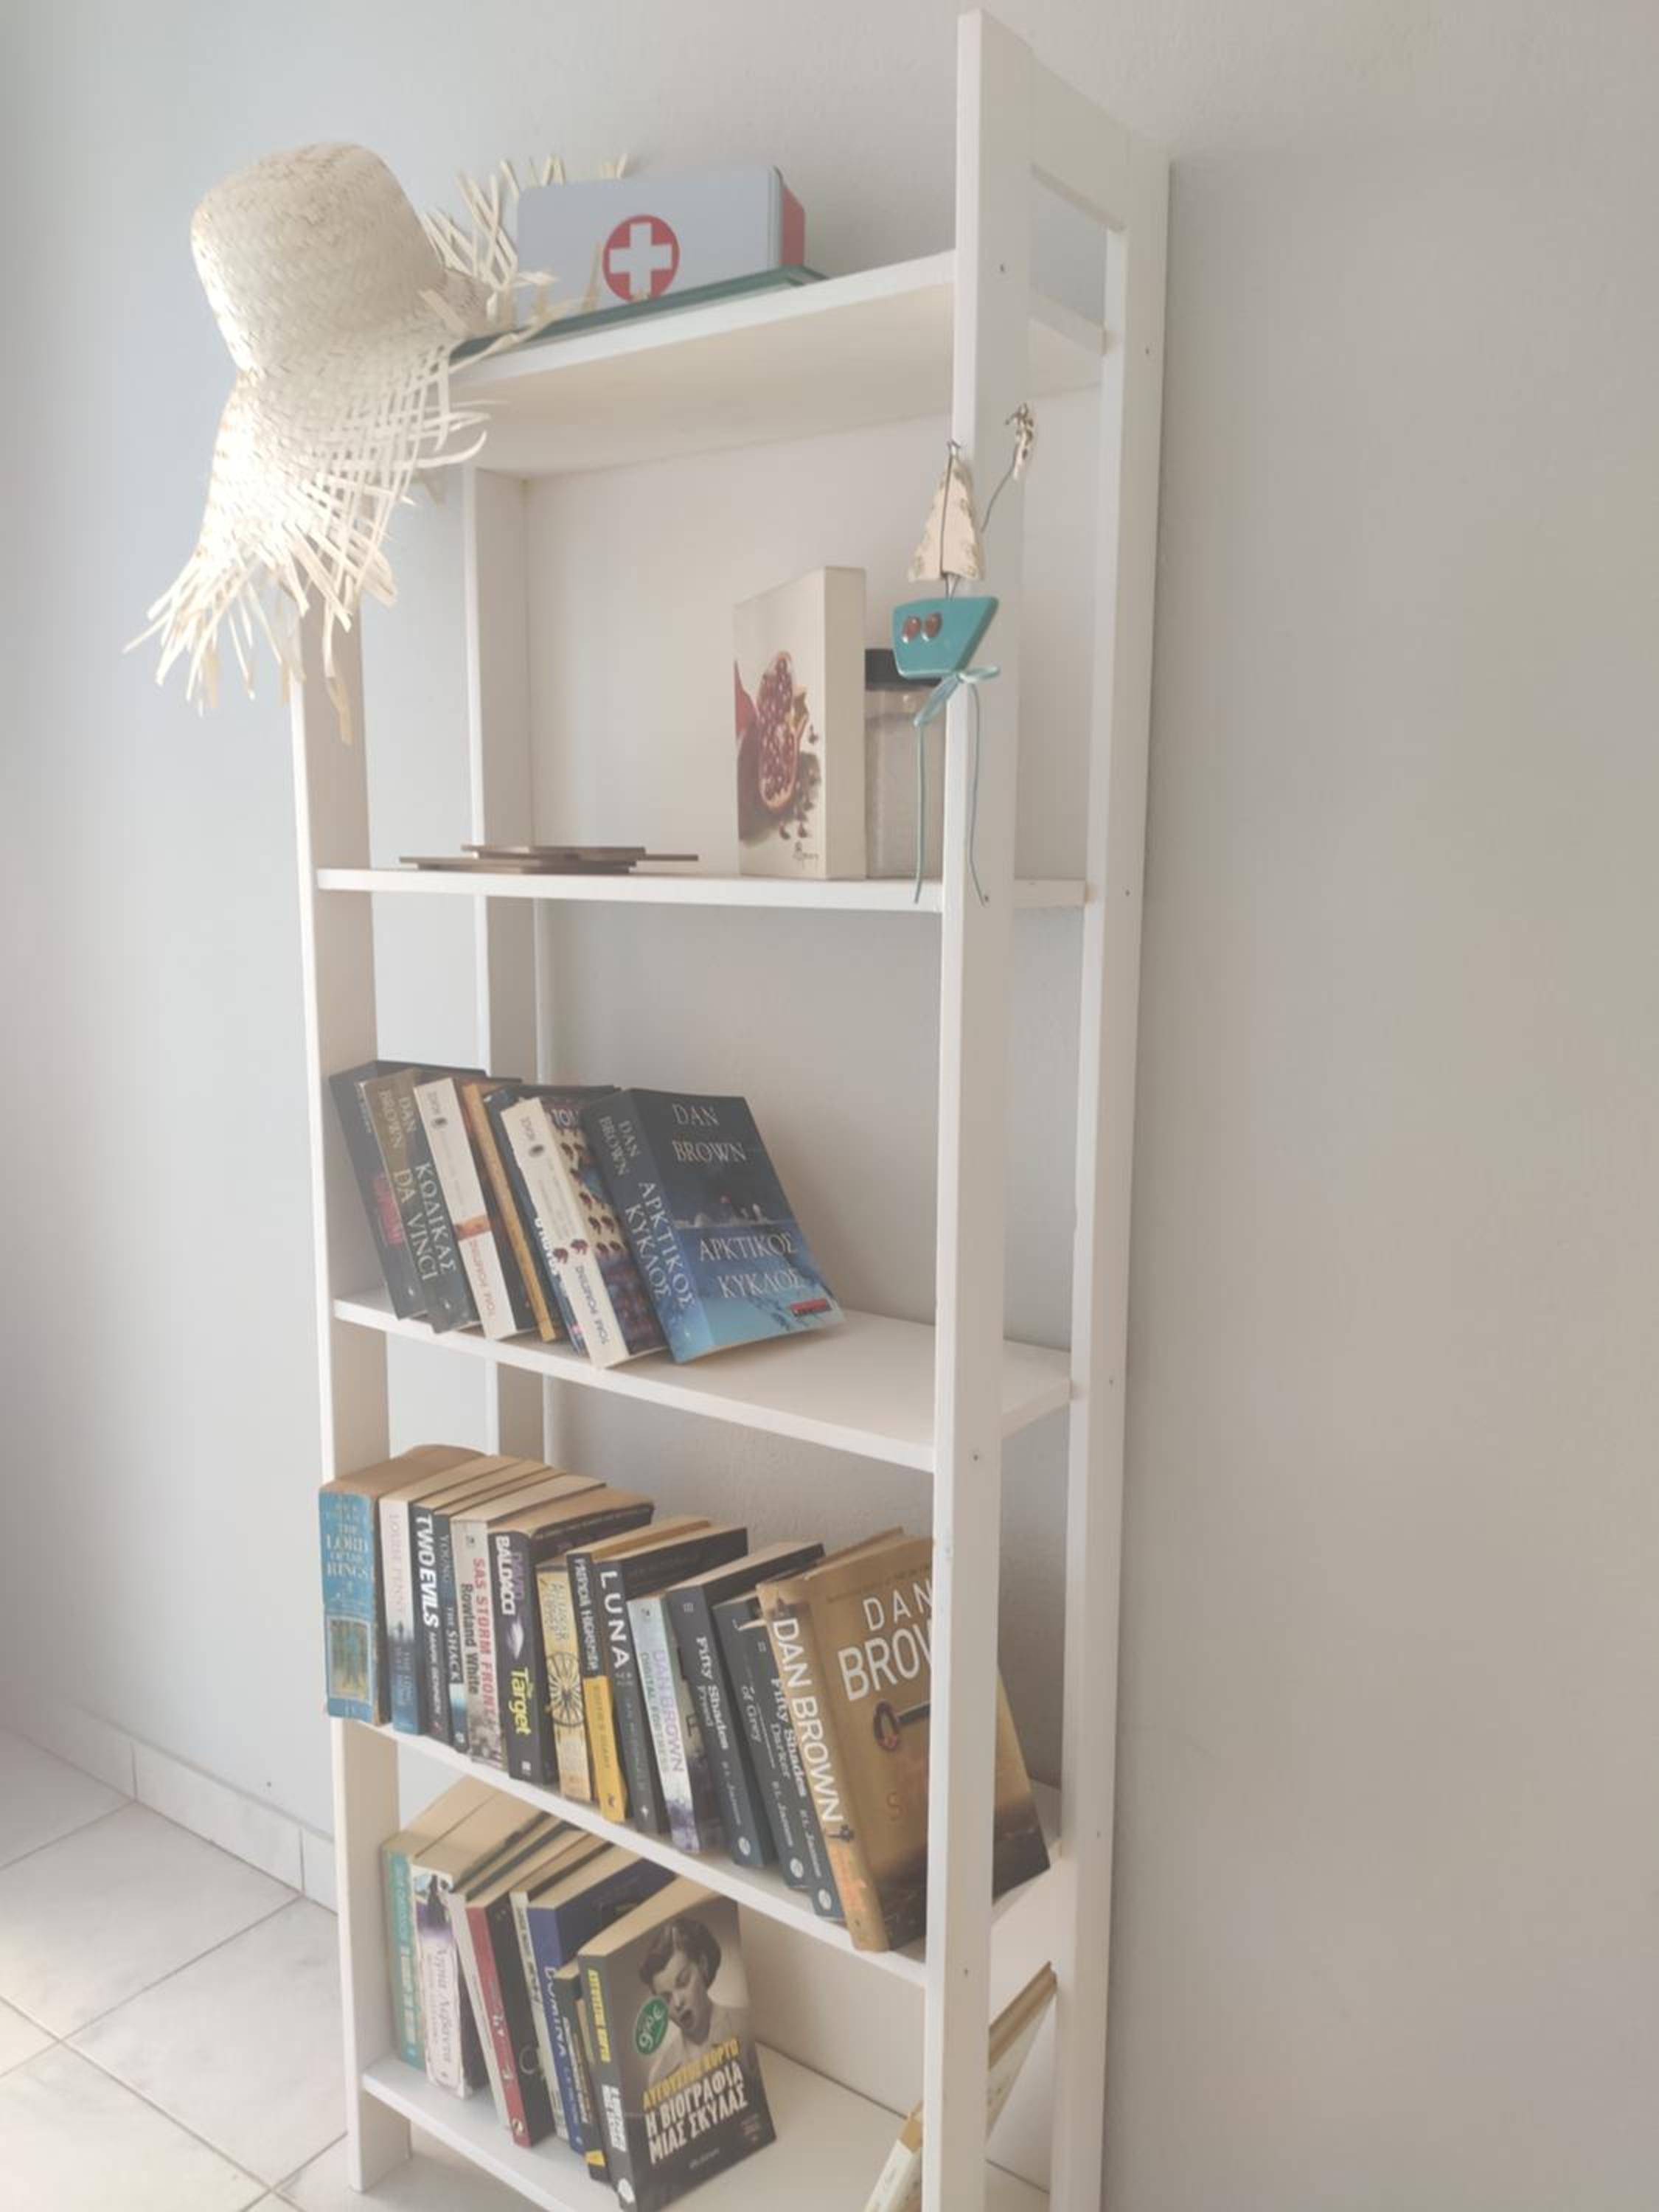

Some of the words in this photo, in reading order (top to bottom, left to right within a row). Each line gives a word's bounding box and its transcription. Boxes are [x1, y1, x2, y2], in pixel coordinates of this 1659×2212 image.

[397, 1095, 418, 1133] DAN
[618, 1119, 641, 1159] DAN
[672, 1102, 720, 1127] DAN
[598, 1116, 630, 1177] BROWN
[672, 1139, 748, 1164] BROWN
[393, 1169, 417, 1203] DA
[406, 1214, 439, 1281] VINCI
[414, 1162, 457, 1275] ΚΩΔΙΚΑΣ
[638, 1181, 696, 1310] ΑΡΚΤΙΚΟΣ
[698, 1232, 798, 1263] ΑΡΚΤΙΚΟΣ
[625, 1203, 672, 1299] ΚΥΚΛΟΣ
[717, 1267, 804, 1299] ΚΥΚΛΟΣ
[326, 1534, 369, 1554] LORD
[414, 1514, 437, 1565] TWO
[417, 1568, 442, 1629] EVILS
[473, 1557, 487, 1590] SAS
[495, 1535, 517, 1615] BALDACCI
[459, 1583, 477, 1648] Rowland
[475, 1596, 492, 1657] STORM
[599, 1569, 630, 1669] LUNA
[863, 1579, 932, 1632] DAN
[445, 1628, 462, 1684] SHACK
[465, 1650, 481, 1697] White
[639, 1652, 656, 1705] DIGITAL
[652, 1649, 671, 1695] DAN
[771, 1616, 813, 1688] DAN
[480, 1660, 498, 1720] FRONT
[507, 1666, 532, 1735] Target
[693, 1635, 715, 1686] Fifty
[705, 1684, 732, 1750] Shades
[741, 1685, 755, 1701] of
[658, 1691, 685, 1775] BROWN
[745, 1705, 762, 1743] Grey
[769, 1722, 790, 1778] Darker
[770, 1677, 791, 1724] Fifty
[782, 1728, 810, 1798] Shades
[790, 1696, 846, 1824] BROWN
[644, 2110, 658, 2138] Η
[659, 2063, 745, 2130] ΒΙΟΓΡΑΦΙΑ
[647, 2123, 688, 2165] ΜΙΑΣ
[689, 2084, 749, 2140] ΣΚΥΛΑΣ
